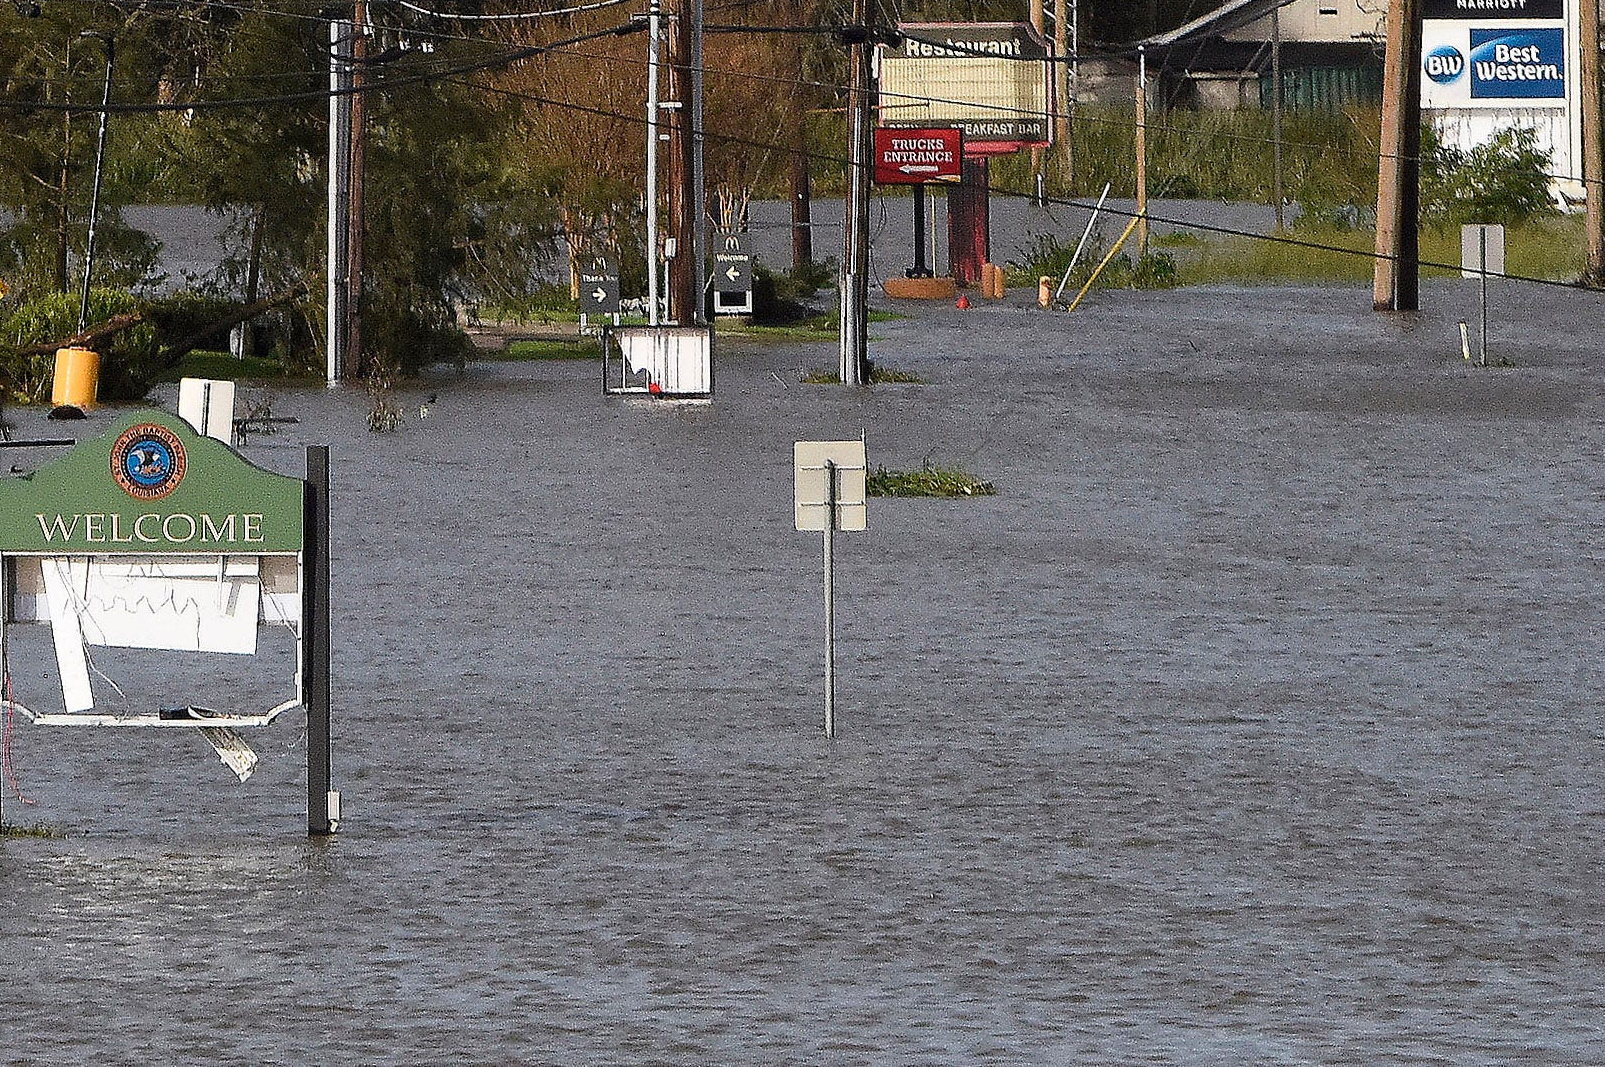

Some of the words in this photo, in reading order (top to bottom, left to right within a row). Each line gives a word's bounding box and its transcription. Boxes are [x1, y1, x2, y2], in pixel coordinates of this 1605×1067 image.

[1495, 44, 1541, 63] Best
[1427, 56, 1463, 76] BW
[890, 138, 945, 151] TRUCKS
[882, 150, 954, 164] ENTRANCE
[35, 513, 265, 543] WELCOME
